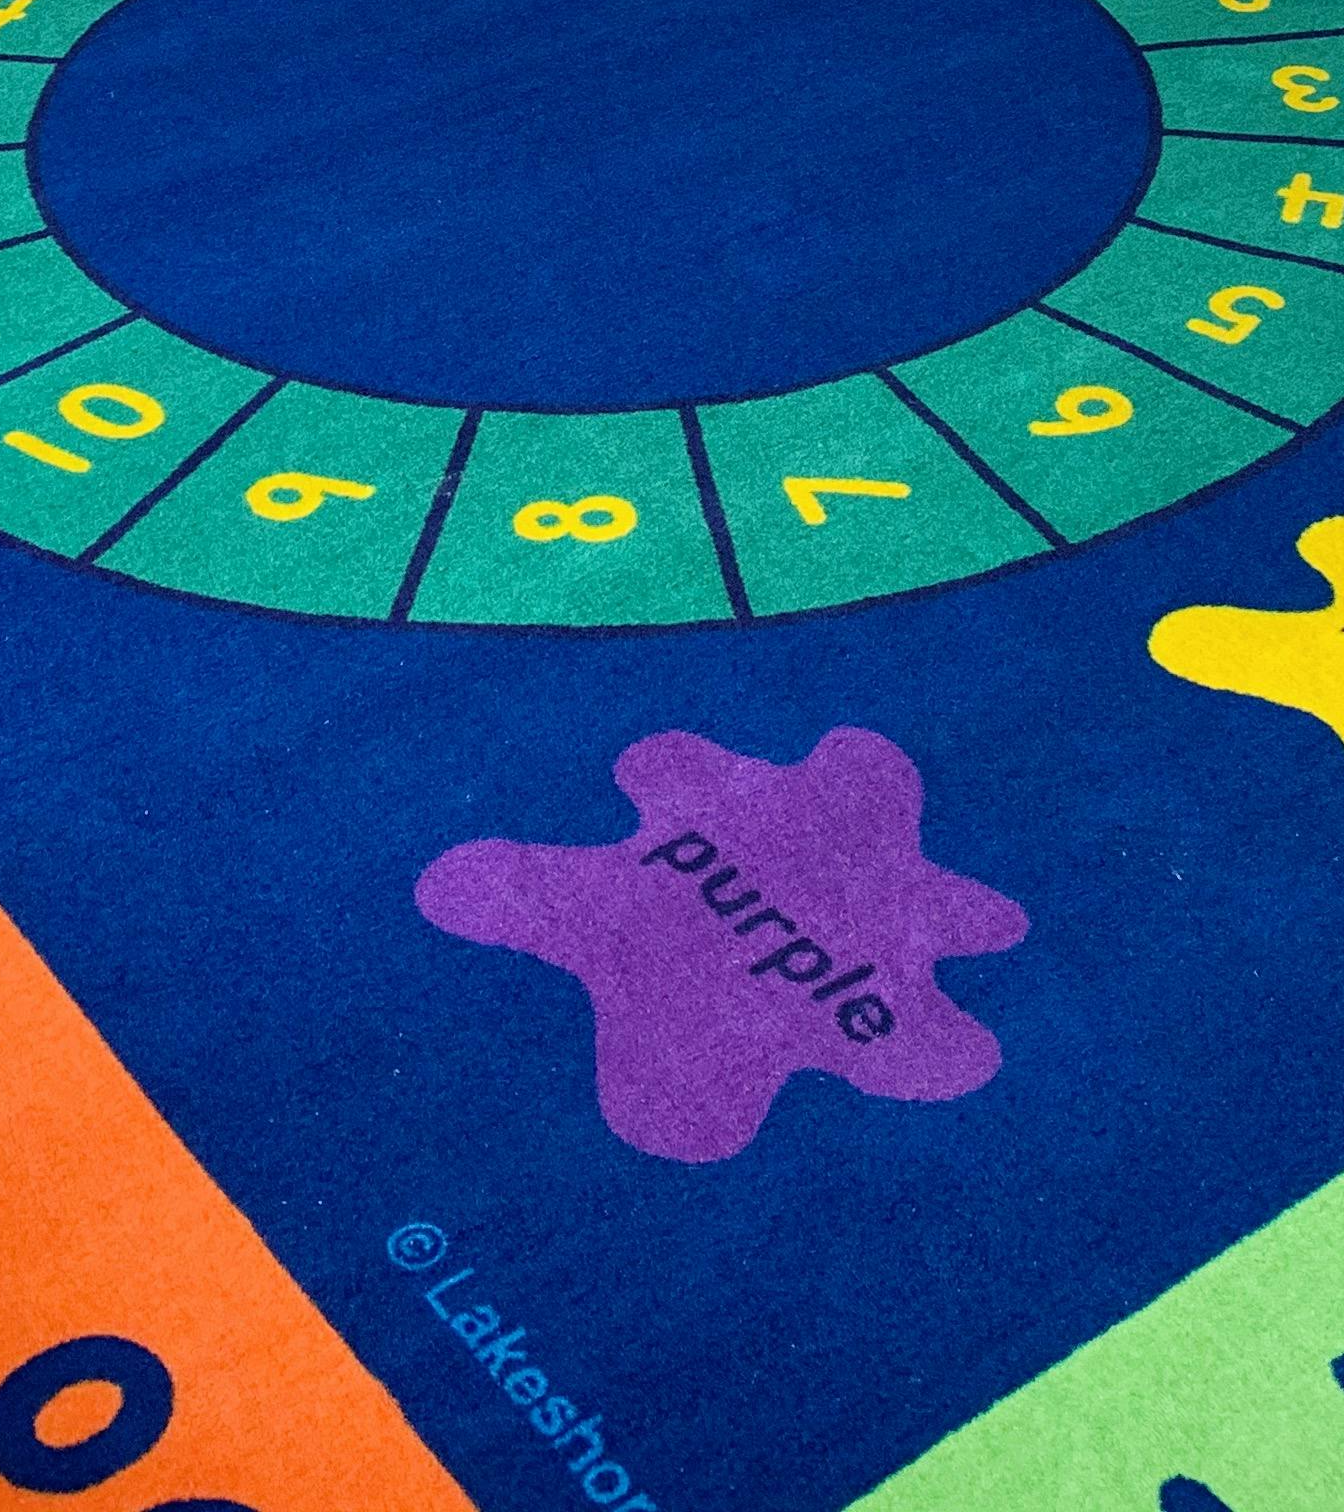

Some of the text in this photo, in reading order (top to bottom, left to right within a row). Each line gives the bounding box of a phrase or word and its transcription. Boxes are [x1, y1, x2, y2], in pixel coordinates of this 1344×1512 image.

[1273, 66, 1338, 111] 3
[1188, 286, 1284, 343] 5
[5, 384, 164, 472] 10
[1030, 387, 1132, 435] 6
[247, 473, 374, 521] 9
[514, 496, 636, 542] 8
[784, 478, 909, 524] 7
[639, 831, 895, 1045] purple
